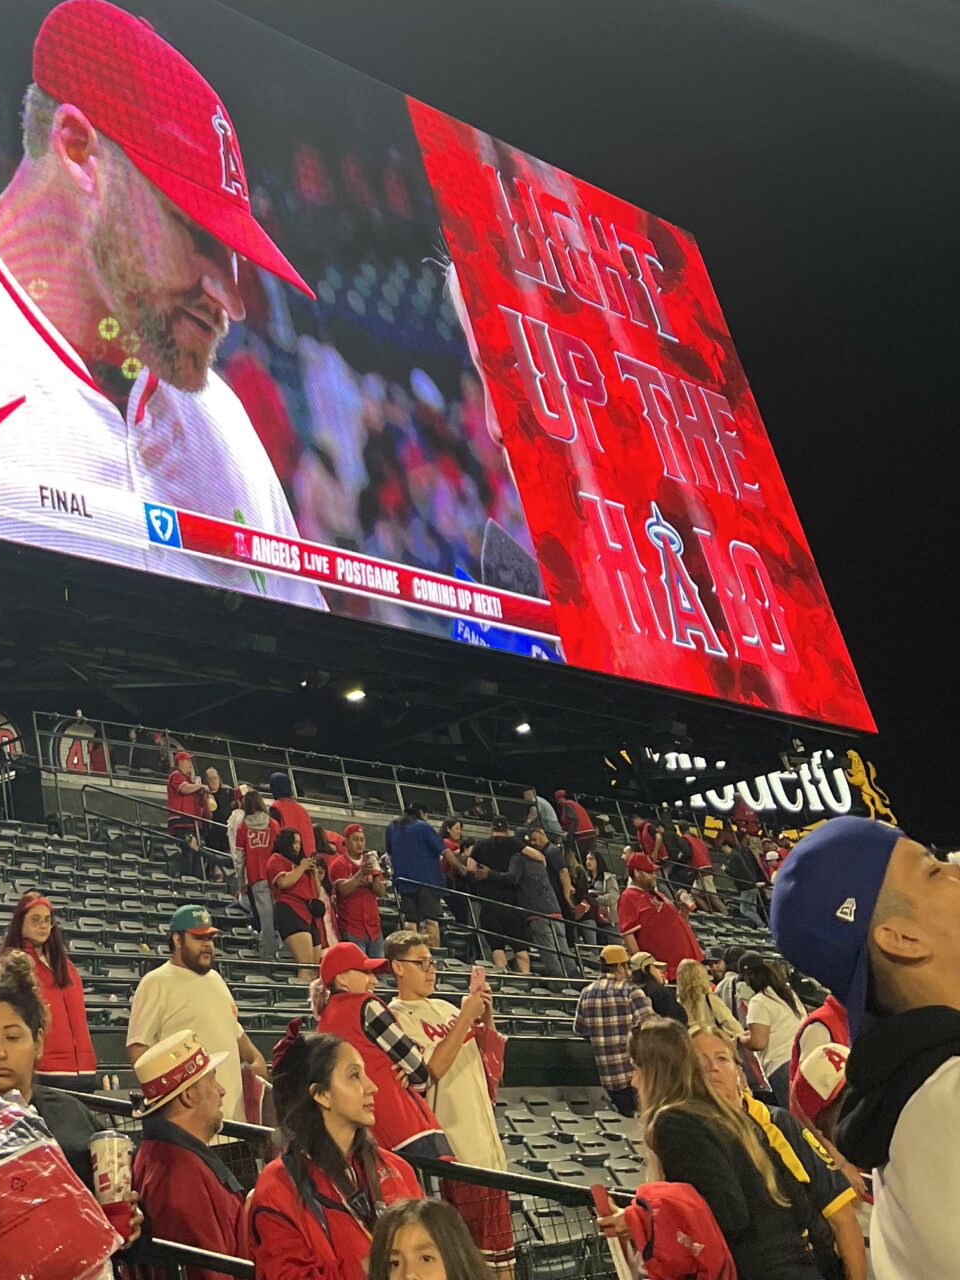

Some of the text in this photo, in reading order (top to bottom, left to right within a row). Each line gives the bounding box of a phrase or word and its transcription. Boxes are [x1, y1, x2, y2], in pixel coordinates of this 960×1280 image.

[483, 162, 679, 343] LIGHT
[497, 304, 766, 508] UP THE
[38, 484, 94, 519] FINAL
[252, 535, 301, 571] ANGELS
[304, 551, 330, 574] LIVE
[337, 556, 401, 595] POSTGAME
[413, 577, 457, 608] COMING
[457, 588, 472, 611] UP
[473, 591, 503, 619] NEXT!
[578, 490, 800, 674] HALO
[247, 827, 271, 848] 27
